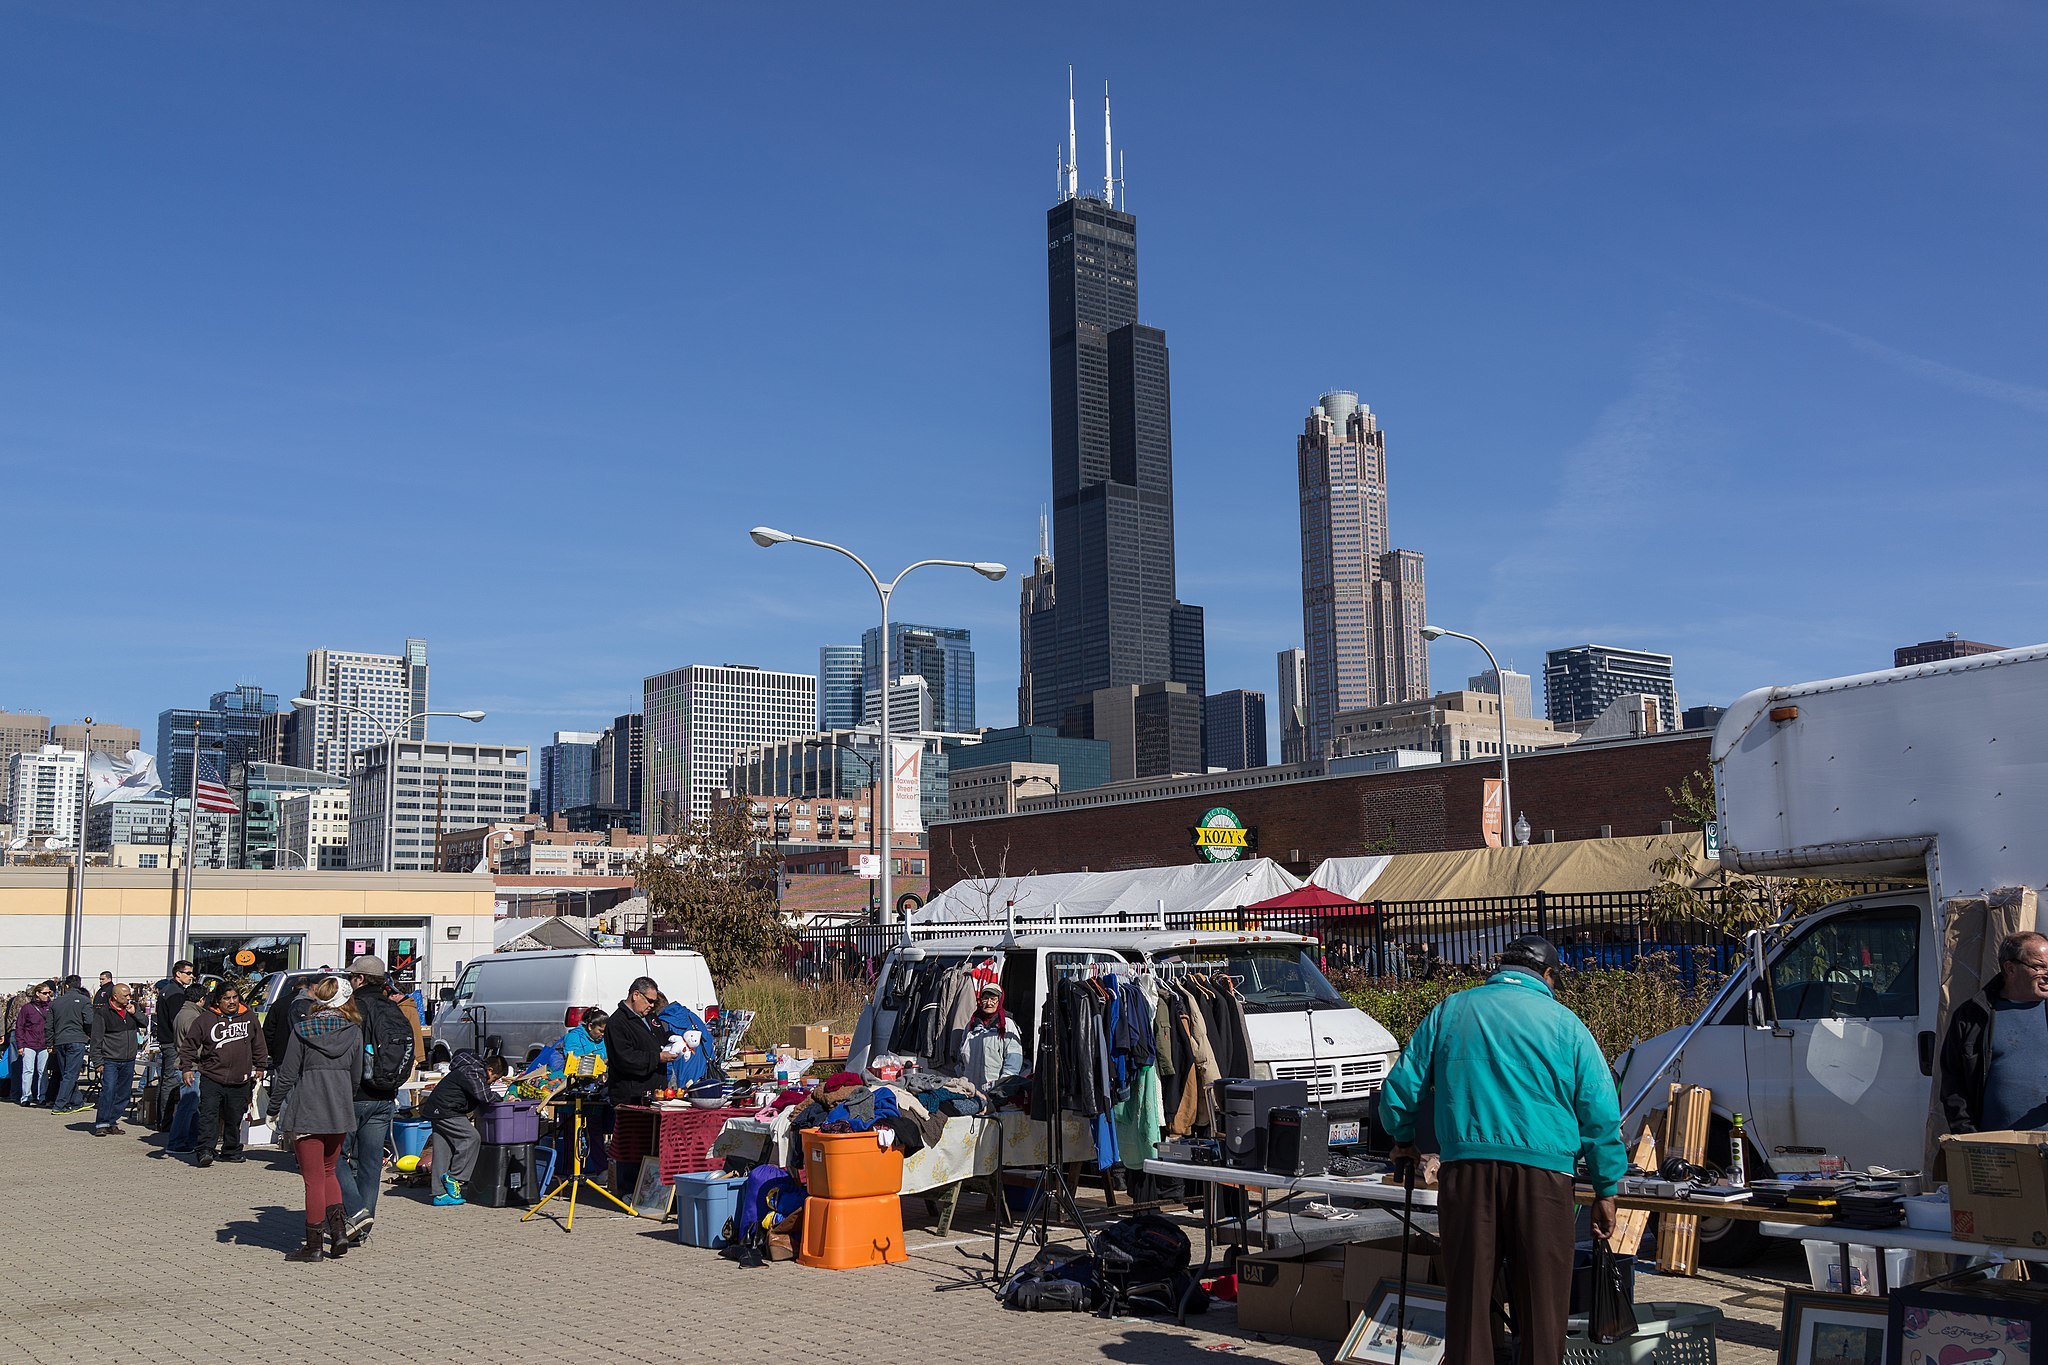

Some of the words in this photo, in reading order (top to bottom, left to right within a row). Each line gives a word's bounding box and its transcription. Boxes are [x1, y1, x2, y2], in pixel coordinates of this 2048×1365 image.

[896, 785, 913, 793] Street
[895, 793, 917, 801] Market
[1205, 808, 1238, 823] BICYCLES
[1203, 830, 1242, 844] KOZY's
[833, 1035, 850, 1045] Dole
[1243, 1264, 1265, 1283] CAT
[1940, 1326, 1958, 1337] Ed
[1955, 1327, 2000, 1345] Hardy
